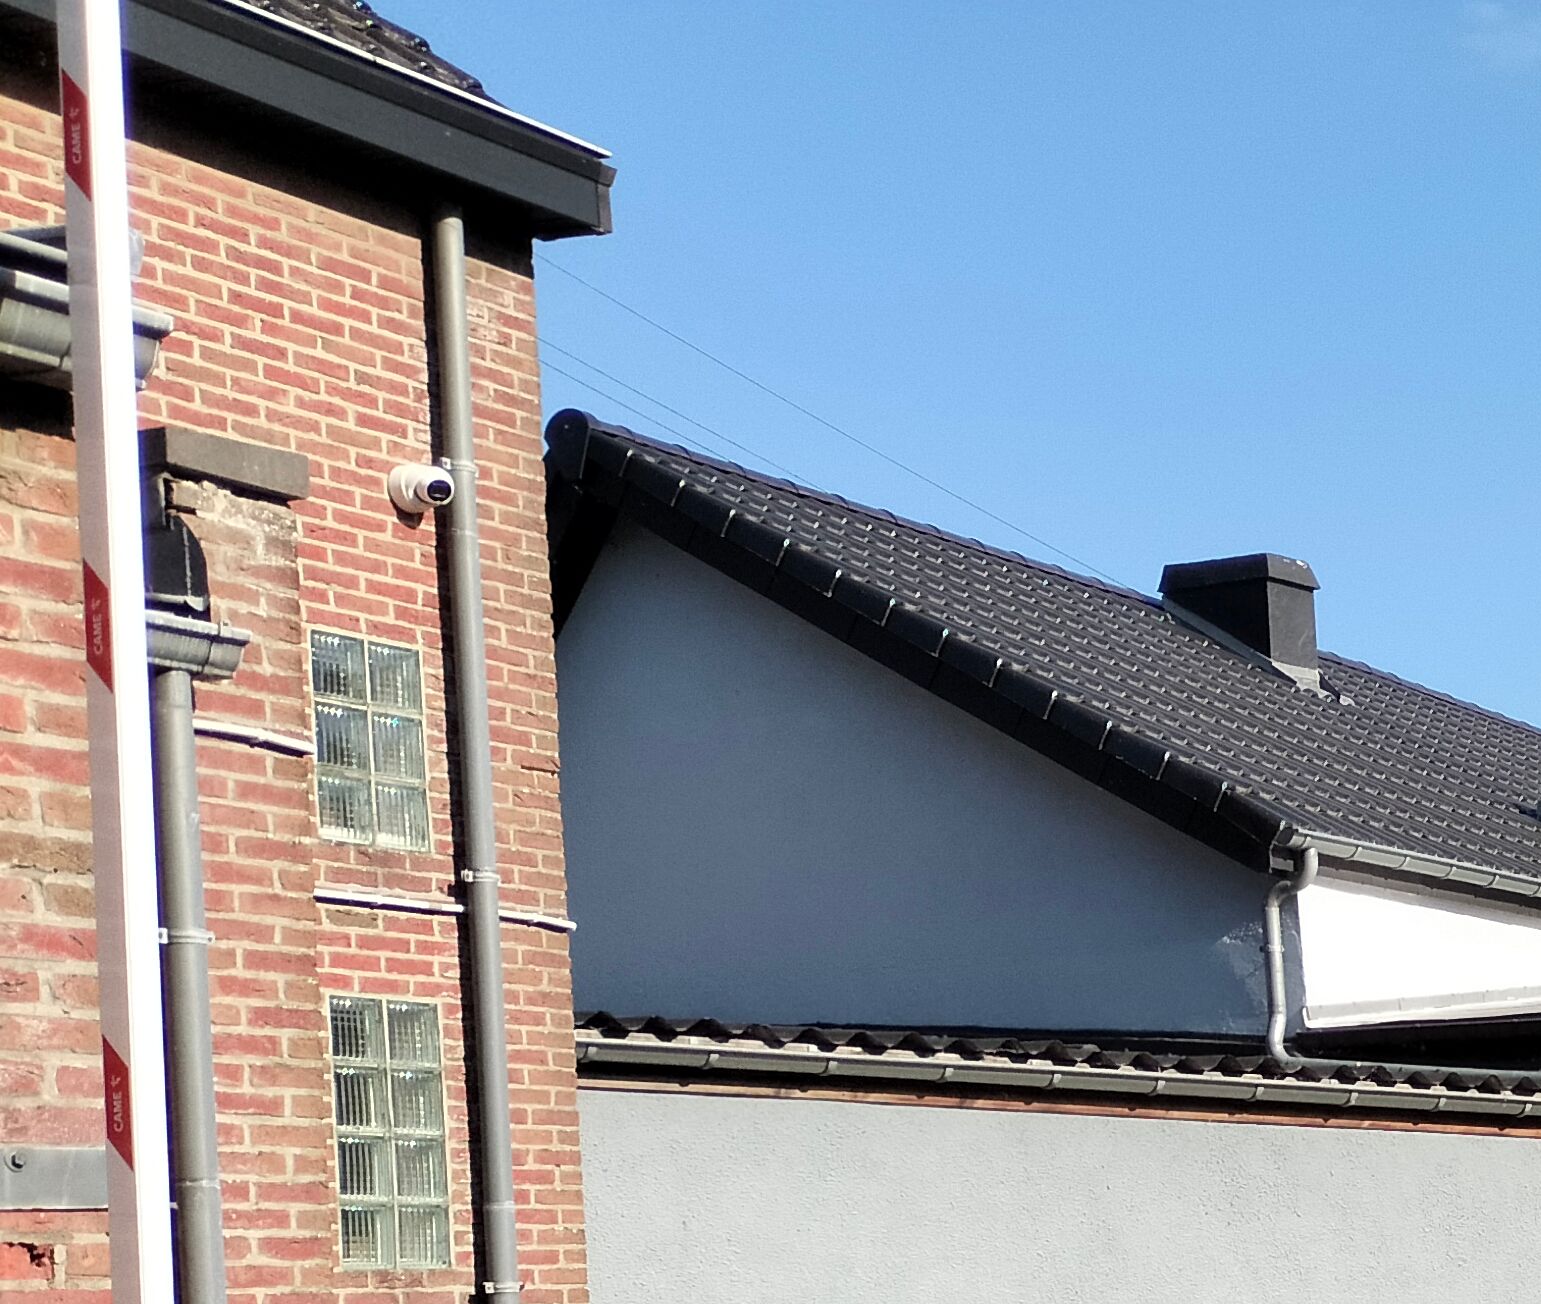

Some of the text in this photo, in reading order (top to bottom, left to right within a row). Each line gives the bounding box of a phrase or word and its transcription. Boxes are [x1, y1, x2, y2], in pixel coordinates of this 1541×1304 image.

[71, 123, 81, 164] CAME
[92, 613, 103, 655] CAME
[112, 1091, 124, 1132] CAME
